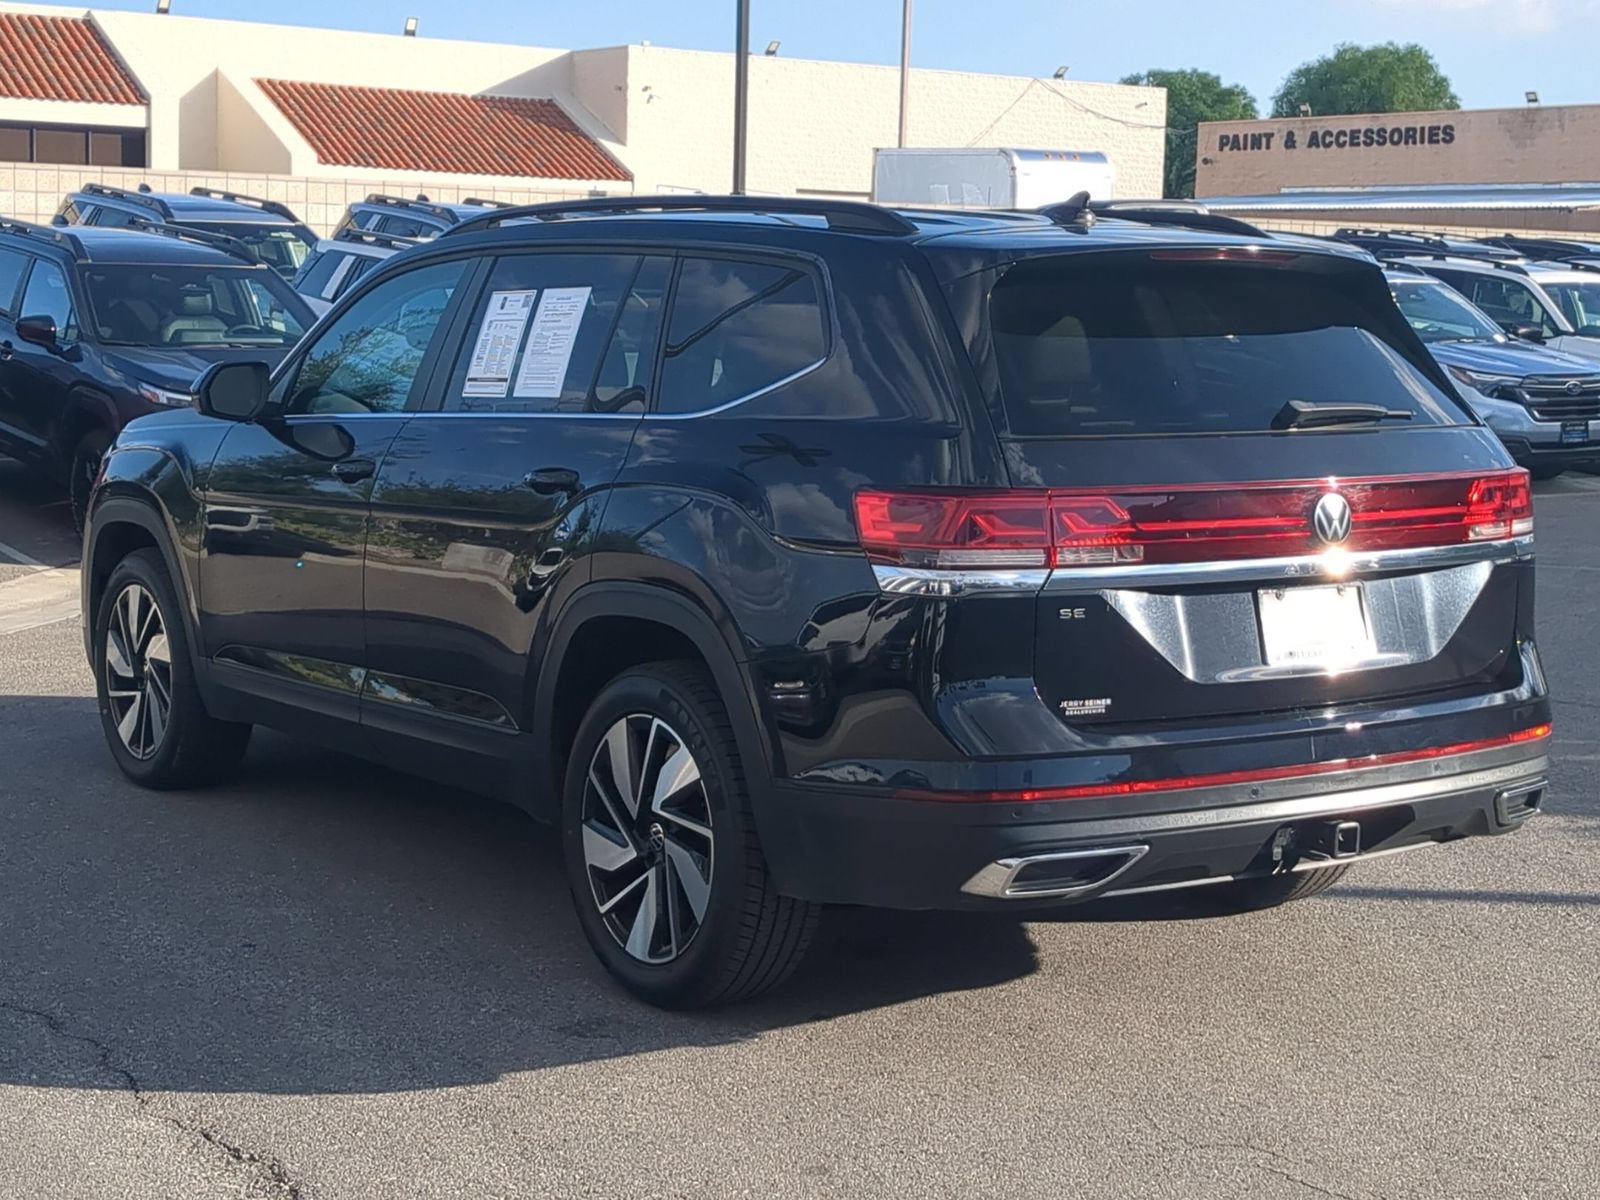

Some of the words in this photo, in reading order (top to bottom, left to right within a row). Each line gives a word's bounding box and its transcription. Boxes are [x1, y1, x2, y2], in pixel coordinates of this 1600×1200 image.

[1218, 132, 1275, 152] PAINT
[1284, 130, 1297, 150] &
[1307, 124, 1456, 149] ACCESSORIES
[1059, 608, 1087, 619] SE
